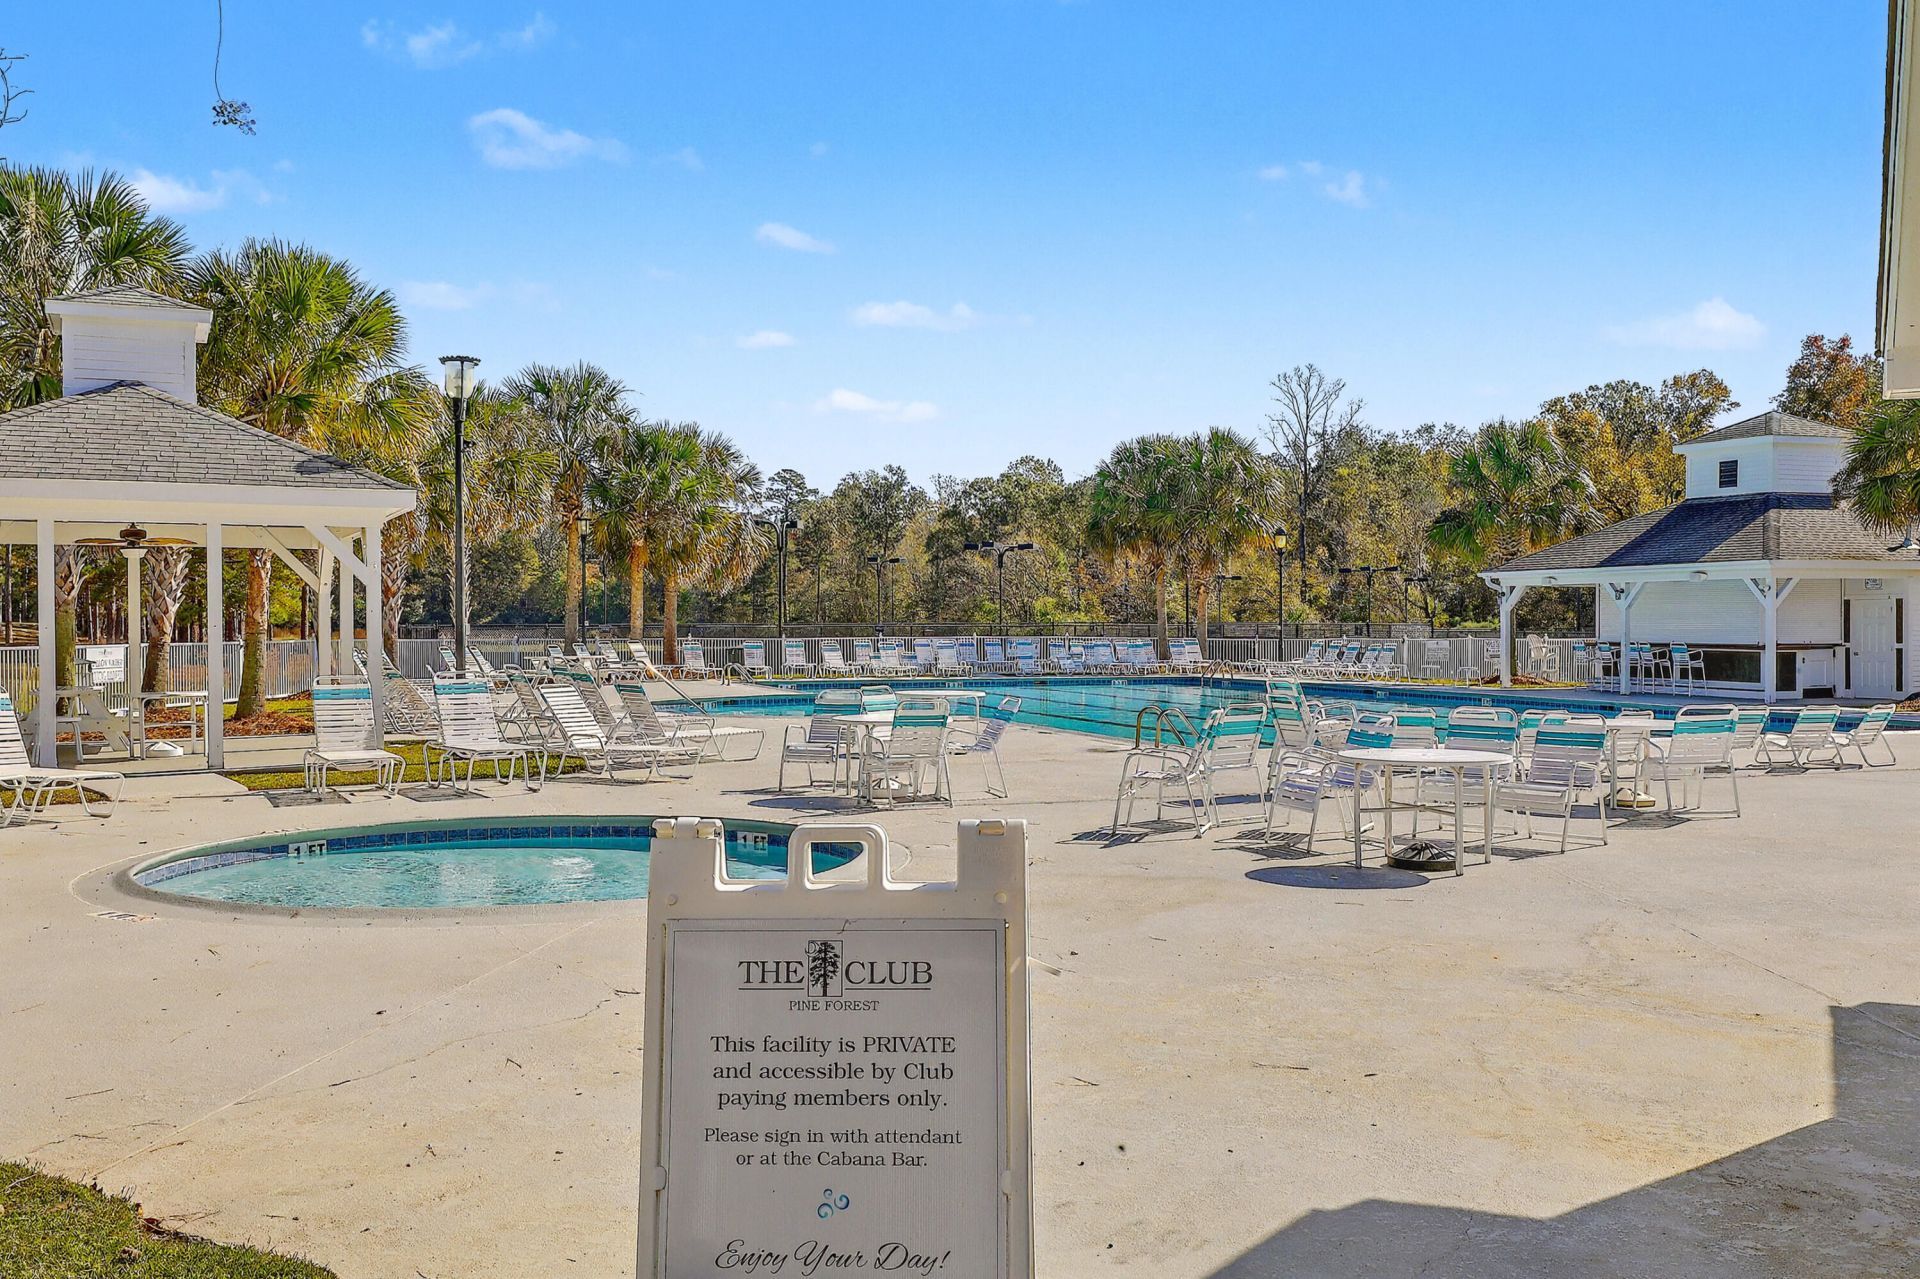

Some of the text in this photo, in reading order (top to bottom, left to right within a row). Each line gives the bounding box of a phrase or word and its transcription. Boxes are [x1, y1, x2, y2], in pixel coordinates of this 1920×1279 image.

[308, 843, 326, 856] FT
[737, 960, 933, 985] THE CLUB
[789, 1000, 880, 1012] PINE FOREST
[710, 1035, 956, 1057] This facility is PRIVATE
[712, 1062, 954, 1084] and accessible by Club
[717, 1089, 948, 1111] paying members only.
[704, 1128, 962, 1147] Please sign in with attendant
[736, 1151, 927, 1167] or at the Cabana Bar.
[715, 1239, 951, 1276] Enjoy Your Day!
